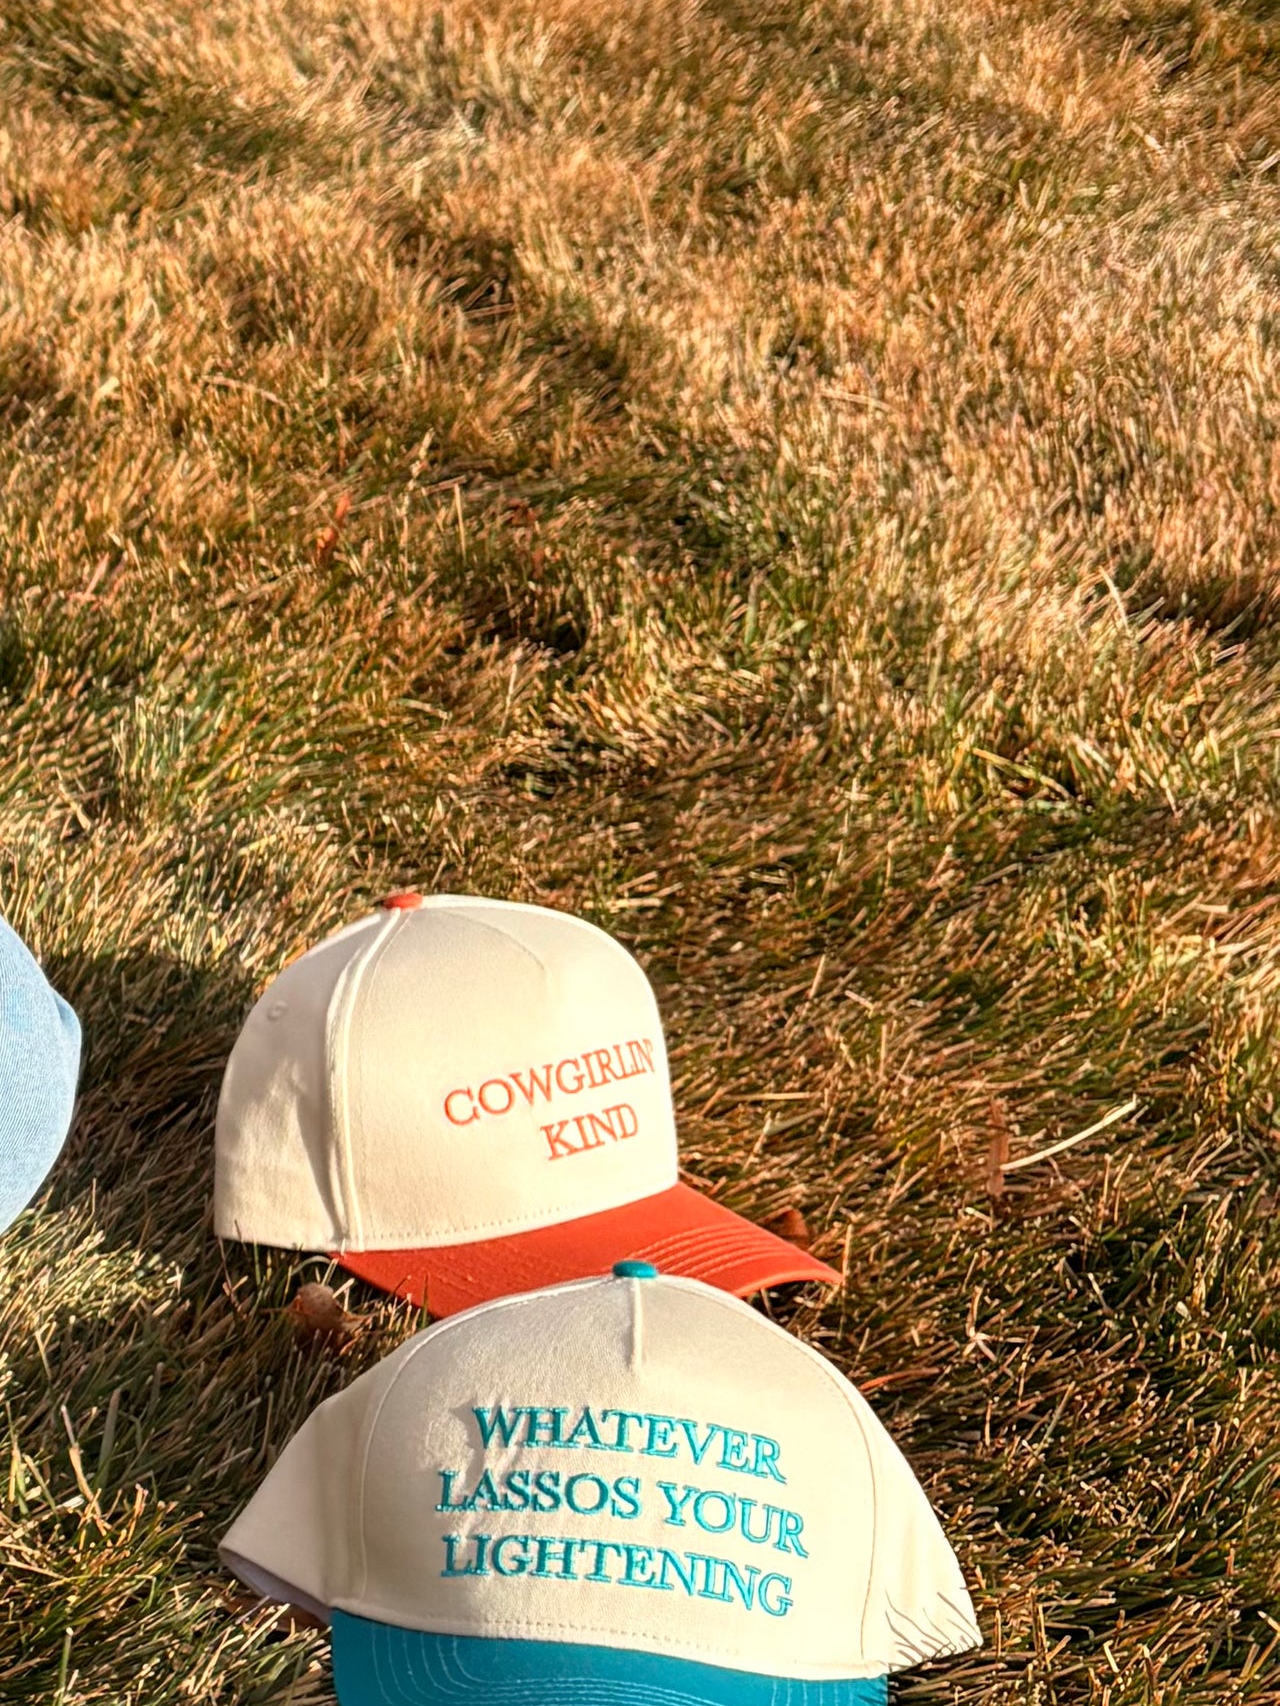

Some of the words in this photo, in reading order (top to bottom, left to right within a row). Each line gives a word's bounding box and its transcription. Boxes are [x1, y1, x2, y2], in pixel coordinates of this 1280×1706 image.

[443, 1038, 656, 1126] COWGIRLIN'
[540, 1103, 639, 1161] KIND
[472, 1405, 788, 1485] WHATEVER
[434, 1468, 642, 1520] LASSOS
[656, 1480, 810, 1560] YOUR
[439, 1533, 794, 1617] LIGHTENING
